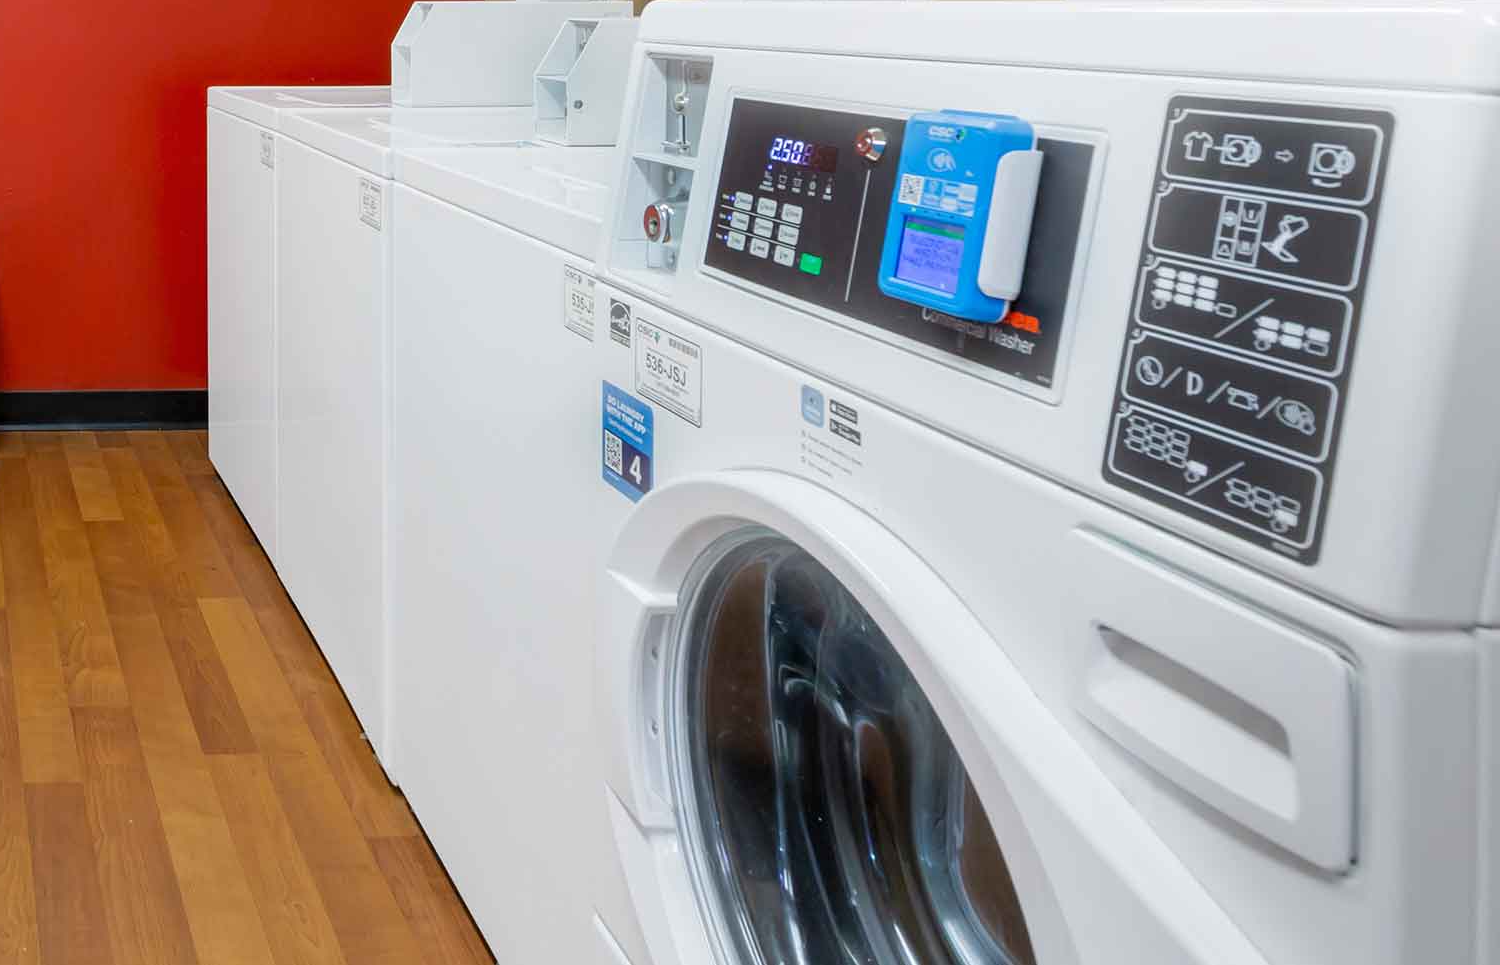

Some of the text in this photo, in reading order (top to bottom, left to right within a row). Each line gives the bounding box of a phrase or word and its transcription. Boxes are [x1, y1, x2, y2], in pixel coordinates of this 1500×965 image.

[1158, 180, 1168, 192] 2
[988, 325, 1035, 355] Washer
[645, 352, 686, 387] 536-JSJ
[629, 455, 642, 485] 4
